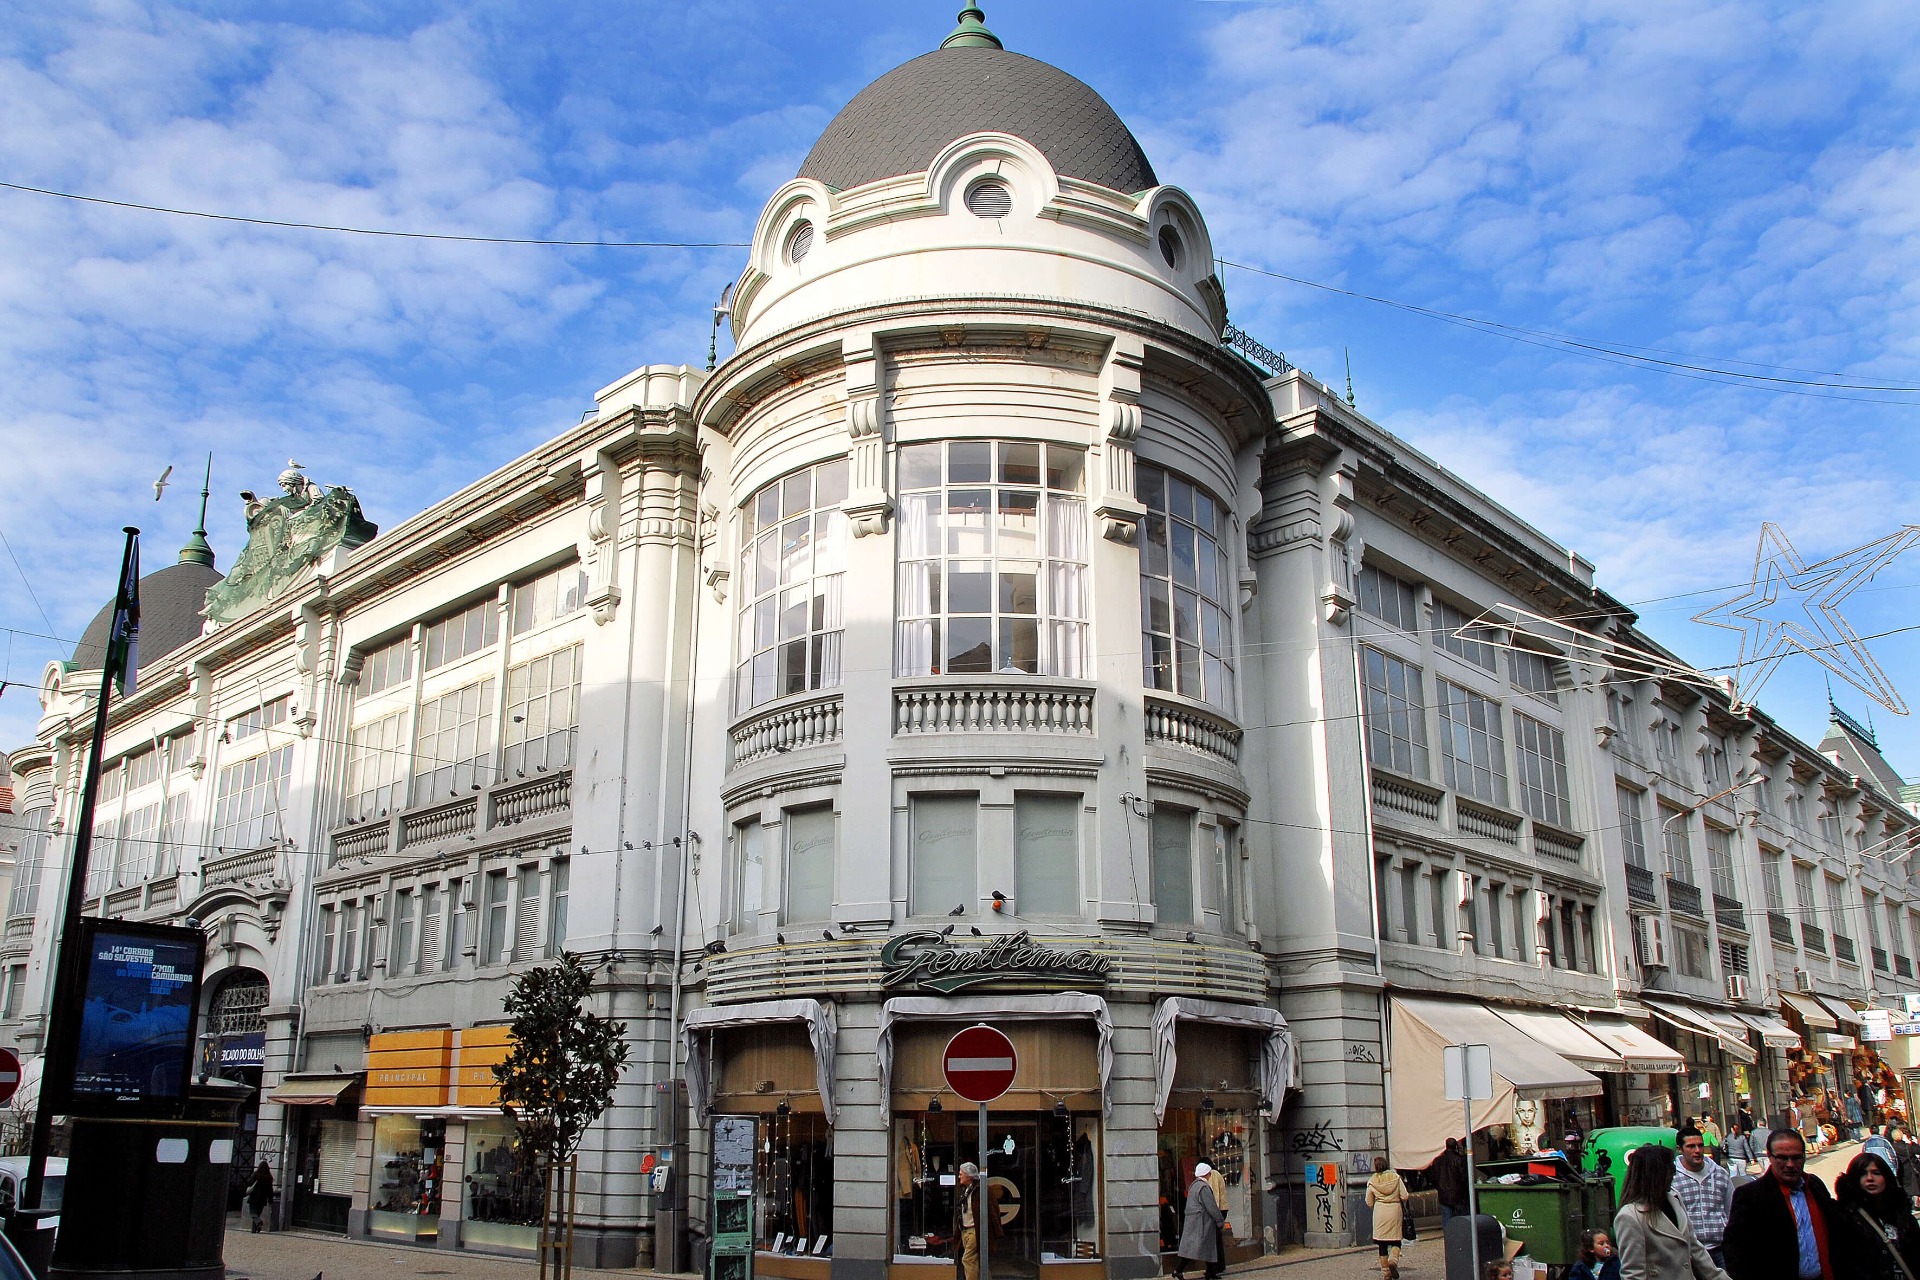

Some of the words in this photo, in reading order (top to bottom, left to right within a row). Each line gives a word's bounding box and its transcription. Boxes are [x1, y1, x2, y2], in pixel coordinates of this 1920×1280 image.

[98, 951, 113, 960] SÃO
[114, 953, 153, 964] SILVESTRE
[123, 946, 154, 957] CORRIDA
[879, 929, 1111, 987] Gentleman
[379, 1073, 427, 1082] PRINCIPAL
